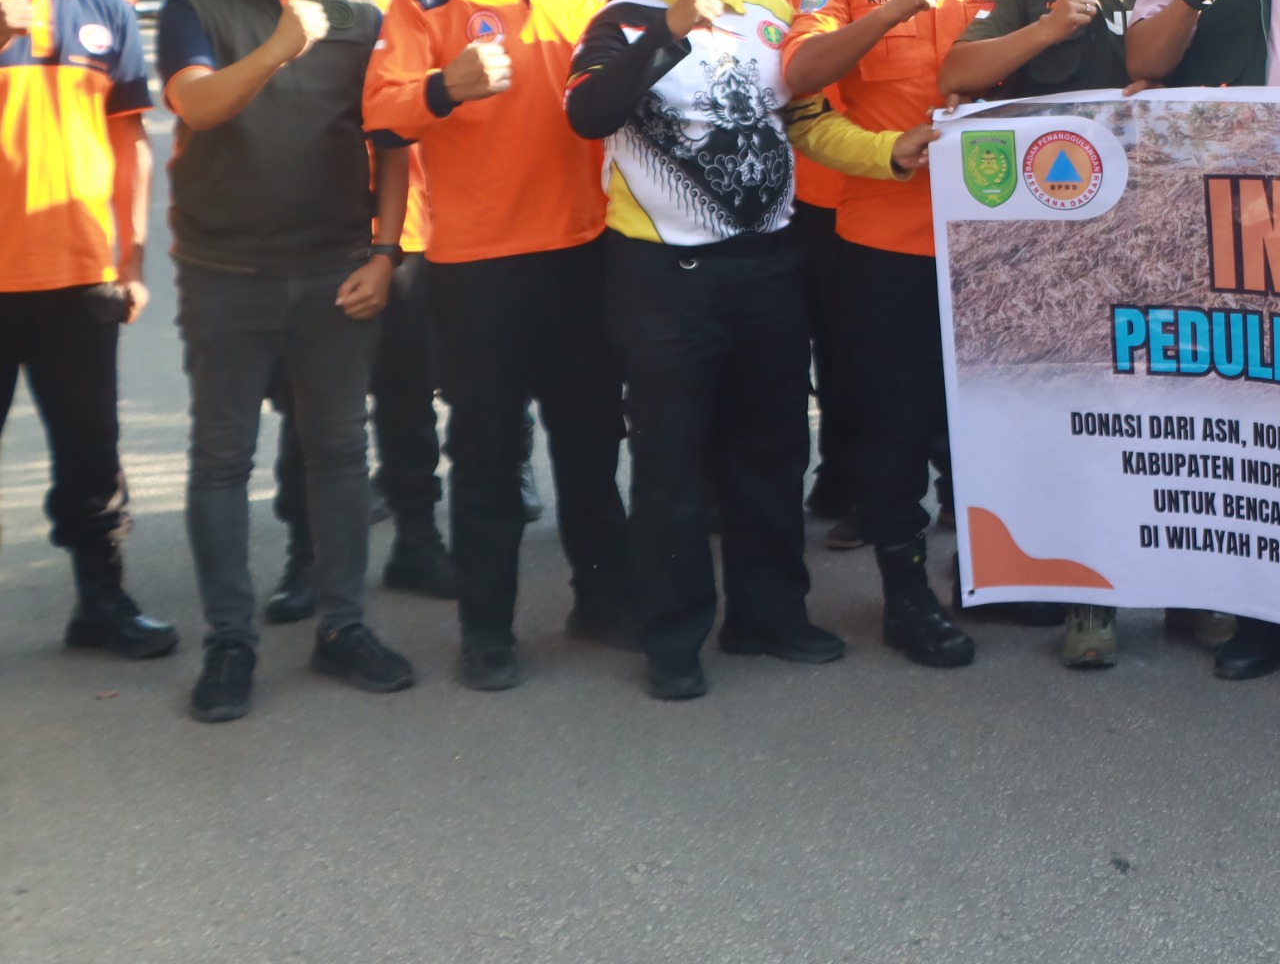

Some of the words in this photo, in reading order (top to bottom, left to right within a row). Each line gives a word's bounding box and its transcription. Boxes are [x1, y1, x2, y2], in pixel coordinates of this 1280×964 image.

[1025, 146, 1039, 172] BADAN
[1037, 133, 1100, 172] PENANGGULANGAN
[1025, 174, 1066, 208] BENCANA
[1070, 174, 1100, 207] DAERAH
[1070, 411, 1142, 439] DONASI
[1149, 415, 1195, 441] DARI
[1202, 417, 1247, 448] ASN,
[1122, 450, 1235, 481] KABUPATEN
[1153, 488, 1217, 516] UNTUK
[1139, 524, 1160, 549] DI
[1165, 525, 1251, 558] WILAYAH
